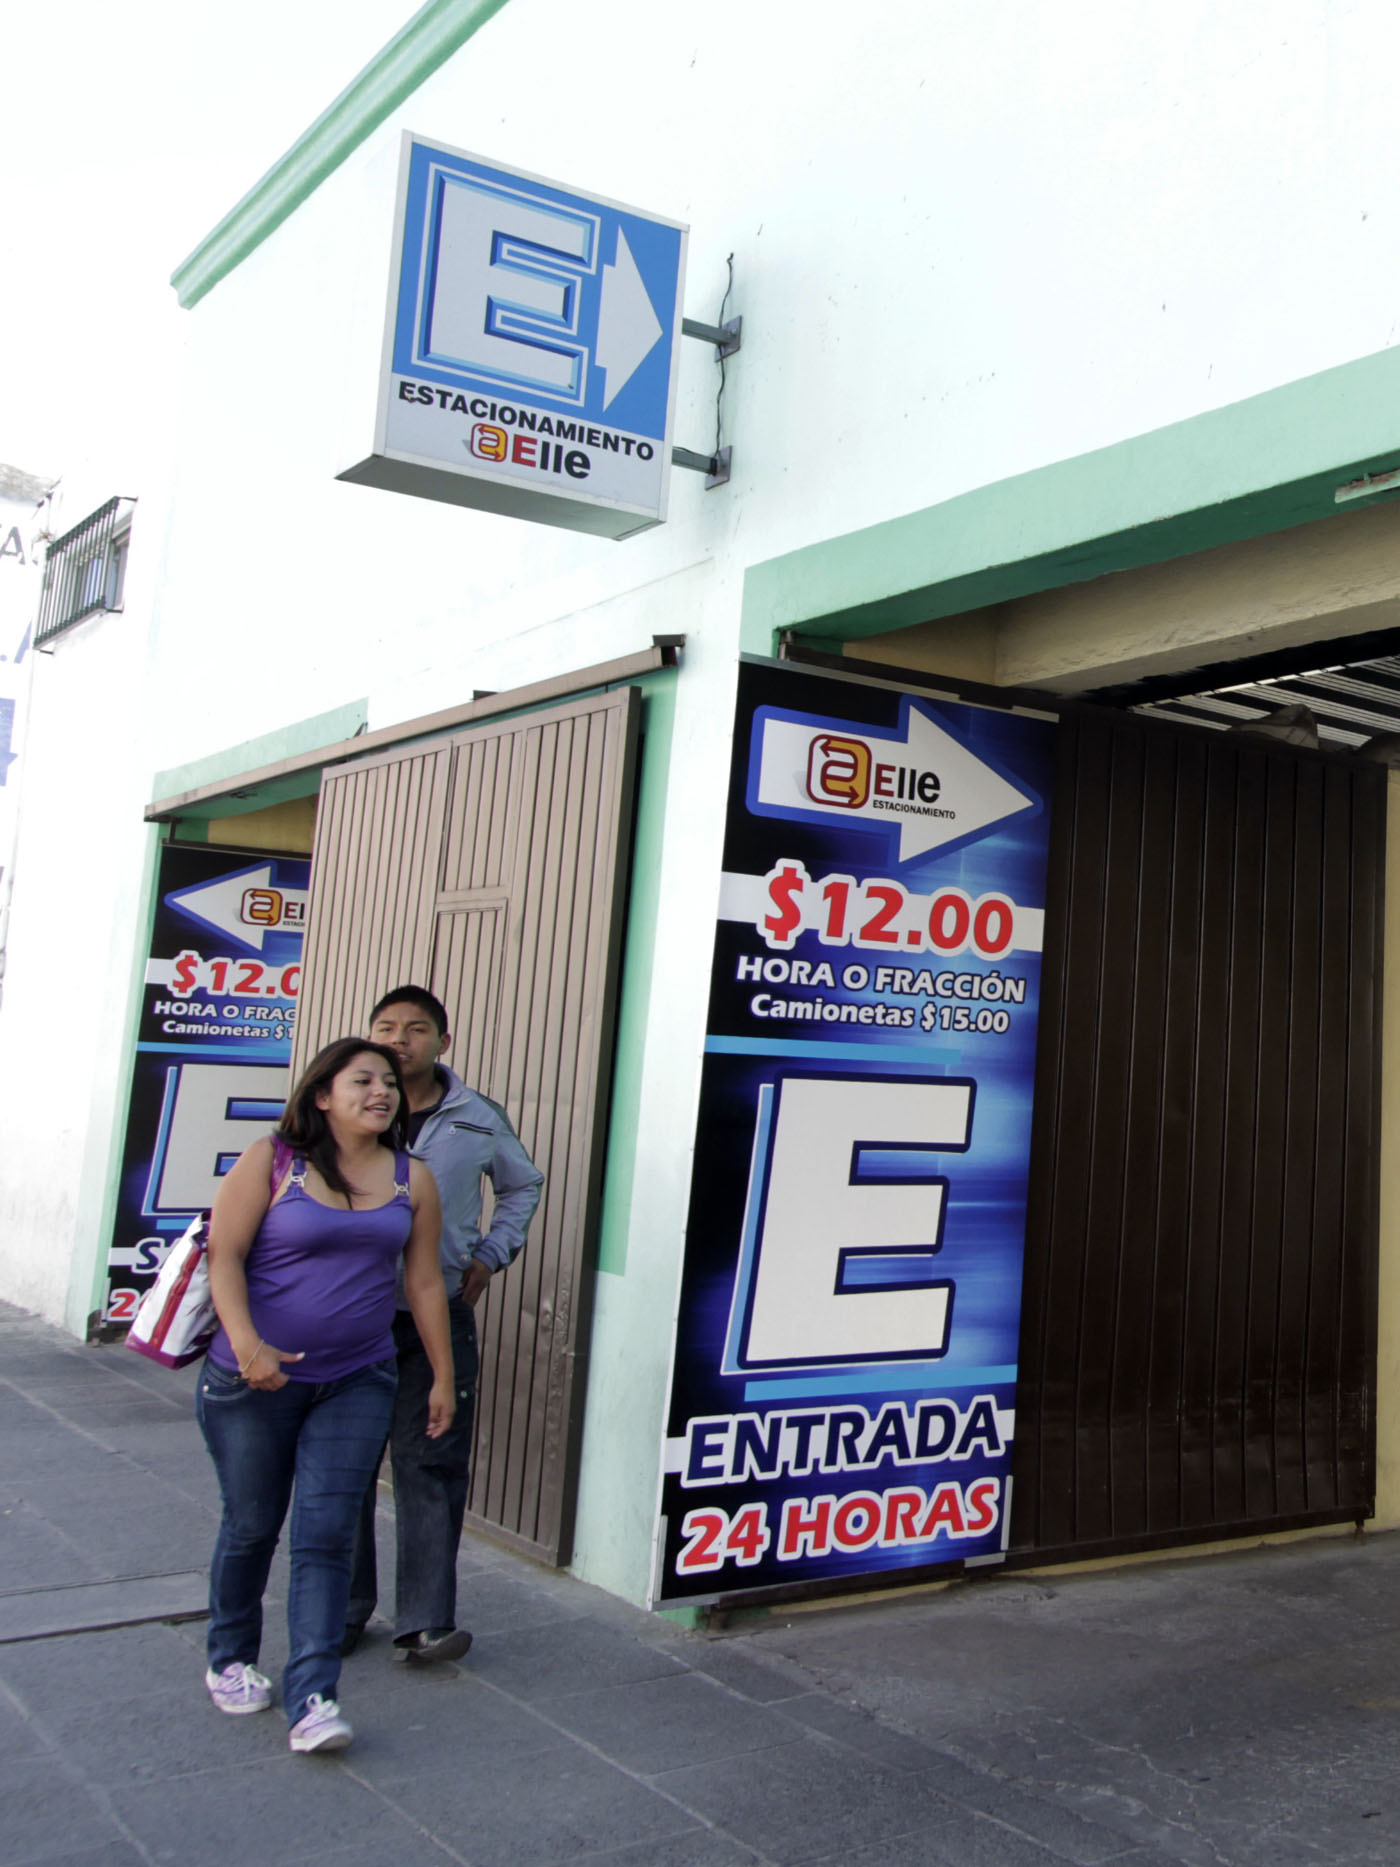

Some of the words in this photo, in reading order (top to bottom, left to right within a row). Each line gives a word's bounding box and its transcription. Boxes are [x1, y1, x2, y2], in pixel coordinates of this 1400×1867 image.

[412, 162, 601, 407] E
[399, 381, 655, 461] ESTACIONAMIENTO
[872, 799, 956, 820] ESTACIONAMIENTO
[764, 866, 1013, 954] $12.00
[154, 1001, 217, 1018] HORA
[222, 1005, 240, 1019] O
[736, 956, 835, 988] HORA
[842, 965, 869, 991] O
[874, 967, 1026, 1003] FRACCIÓN
[751, 993, 915, 1028] Camionetas
[921, 1005, 1009, 1034] $15.00
[162, 1021, 270, 1038] Camionetas
[737, 1071, 978, 1370] E
[686, 1399, 1002, 1482] ENTRADA
[682, 1508, 764, 1568] 24
[782, 1483, 997, 1555] HORAS
